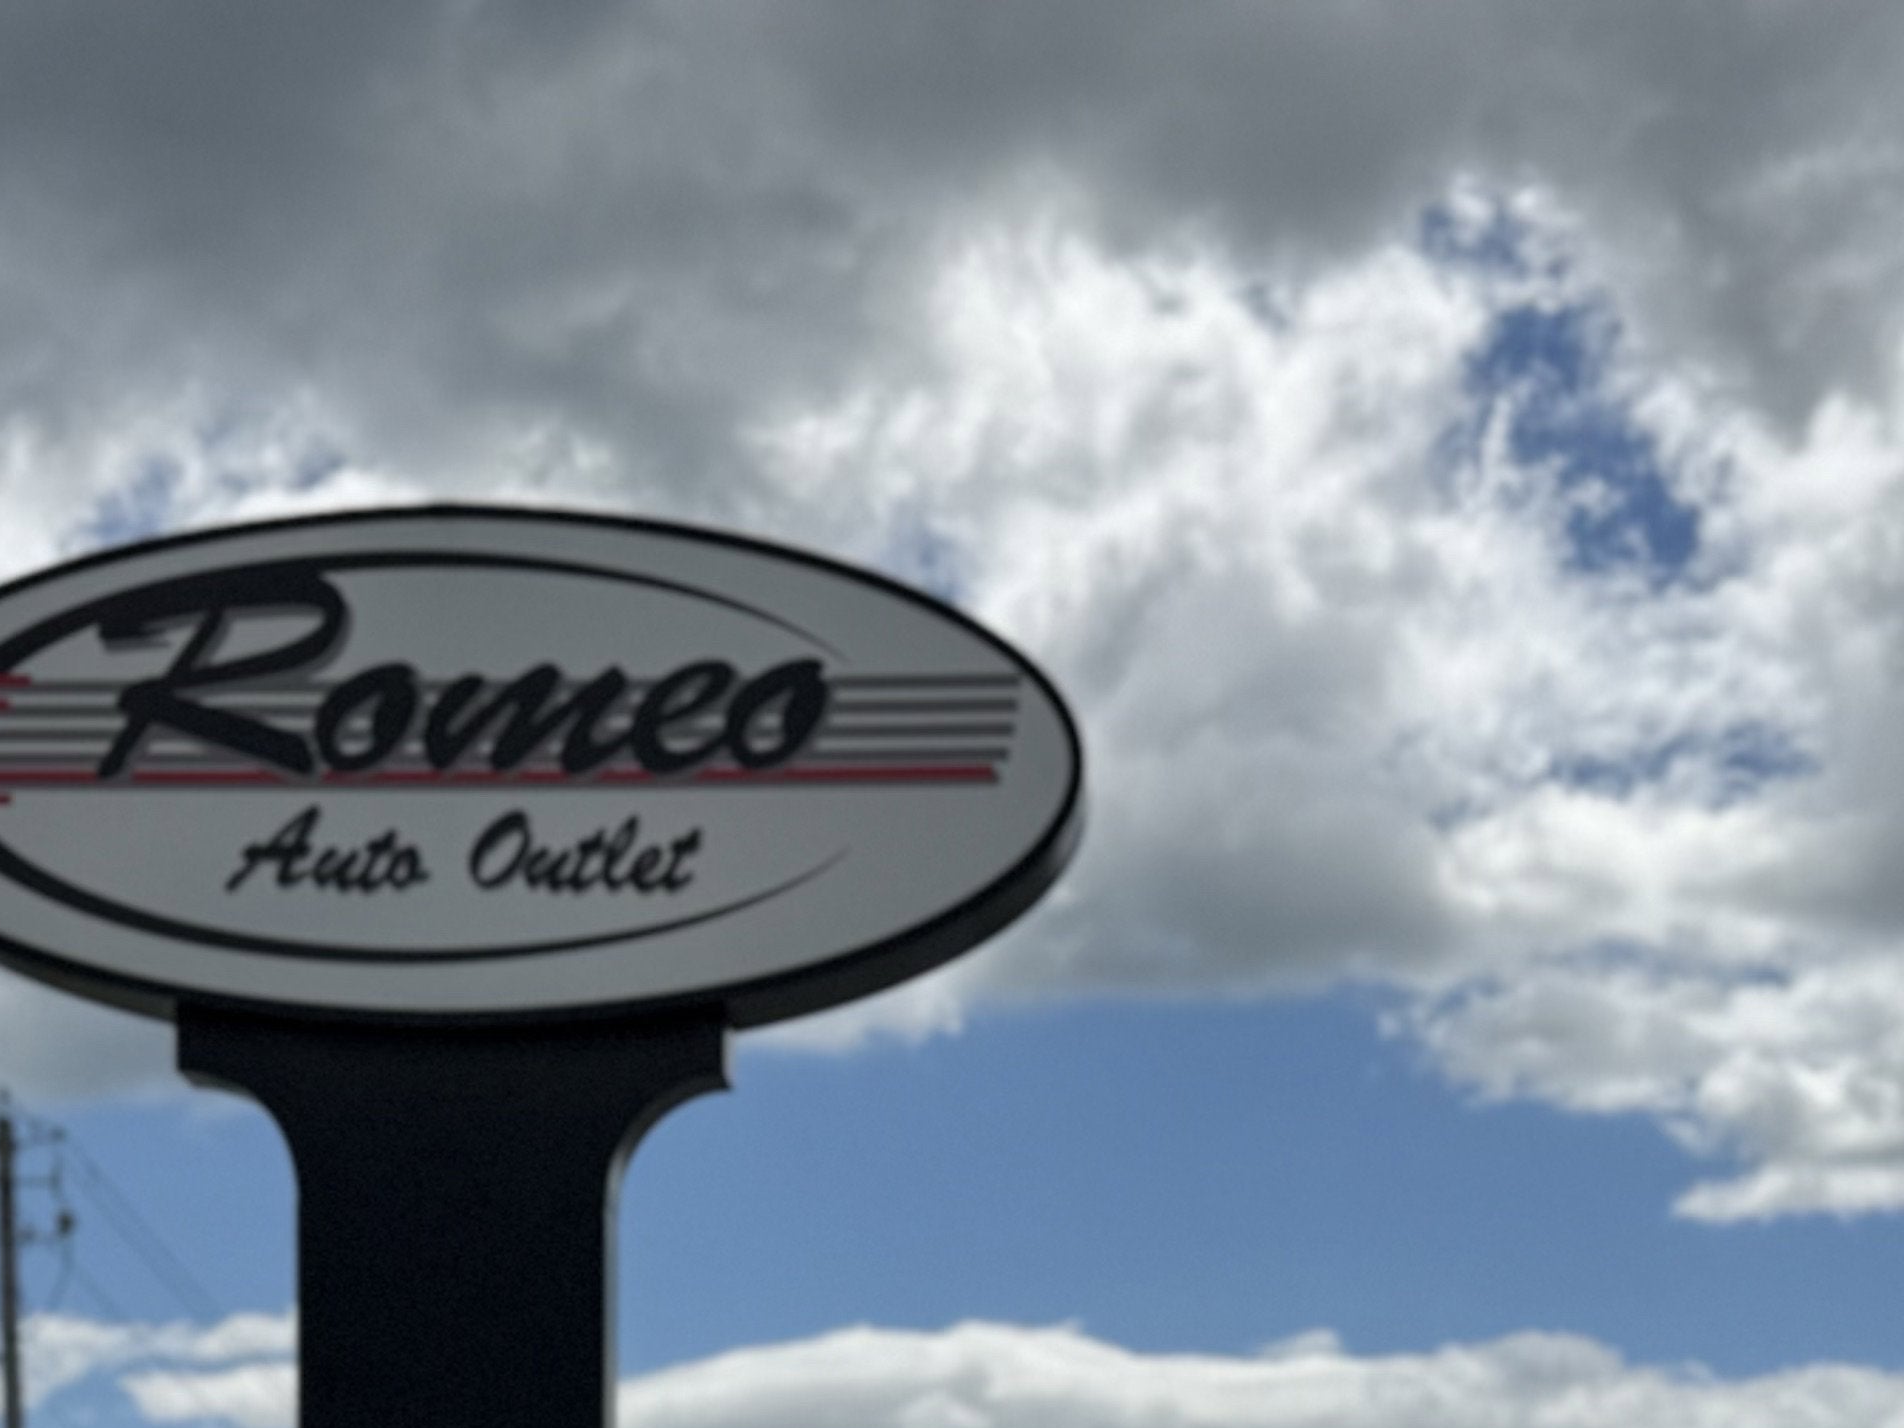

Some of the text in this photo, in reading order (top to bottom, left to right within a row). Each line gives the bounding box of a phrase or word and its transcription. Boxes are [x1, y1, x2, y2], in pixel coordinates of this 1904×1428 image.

[96, 567, 831, 778] Romeo
[227, 806, 704, 894] Auto Outlet
